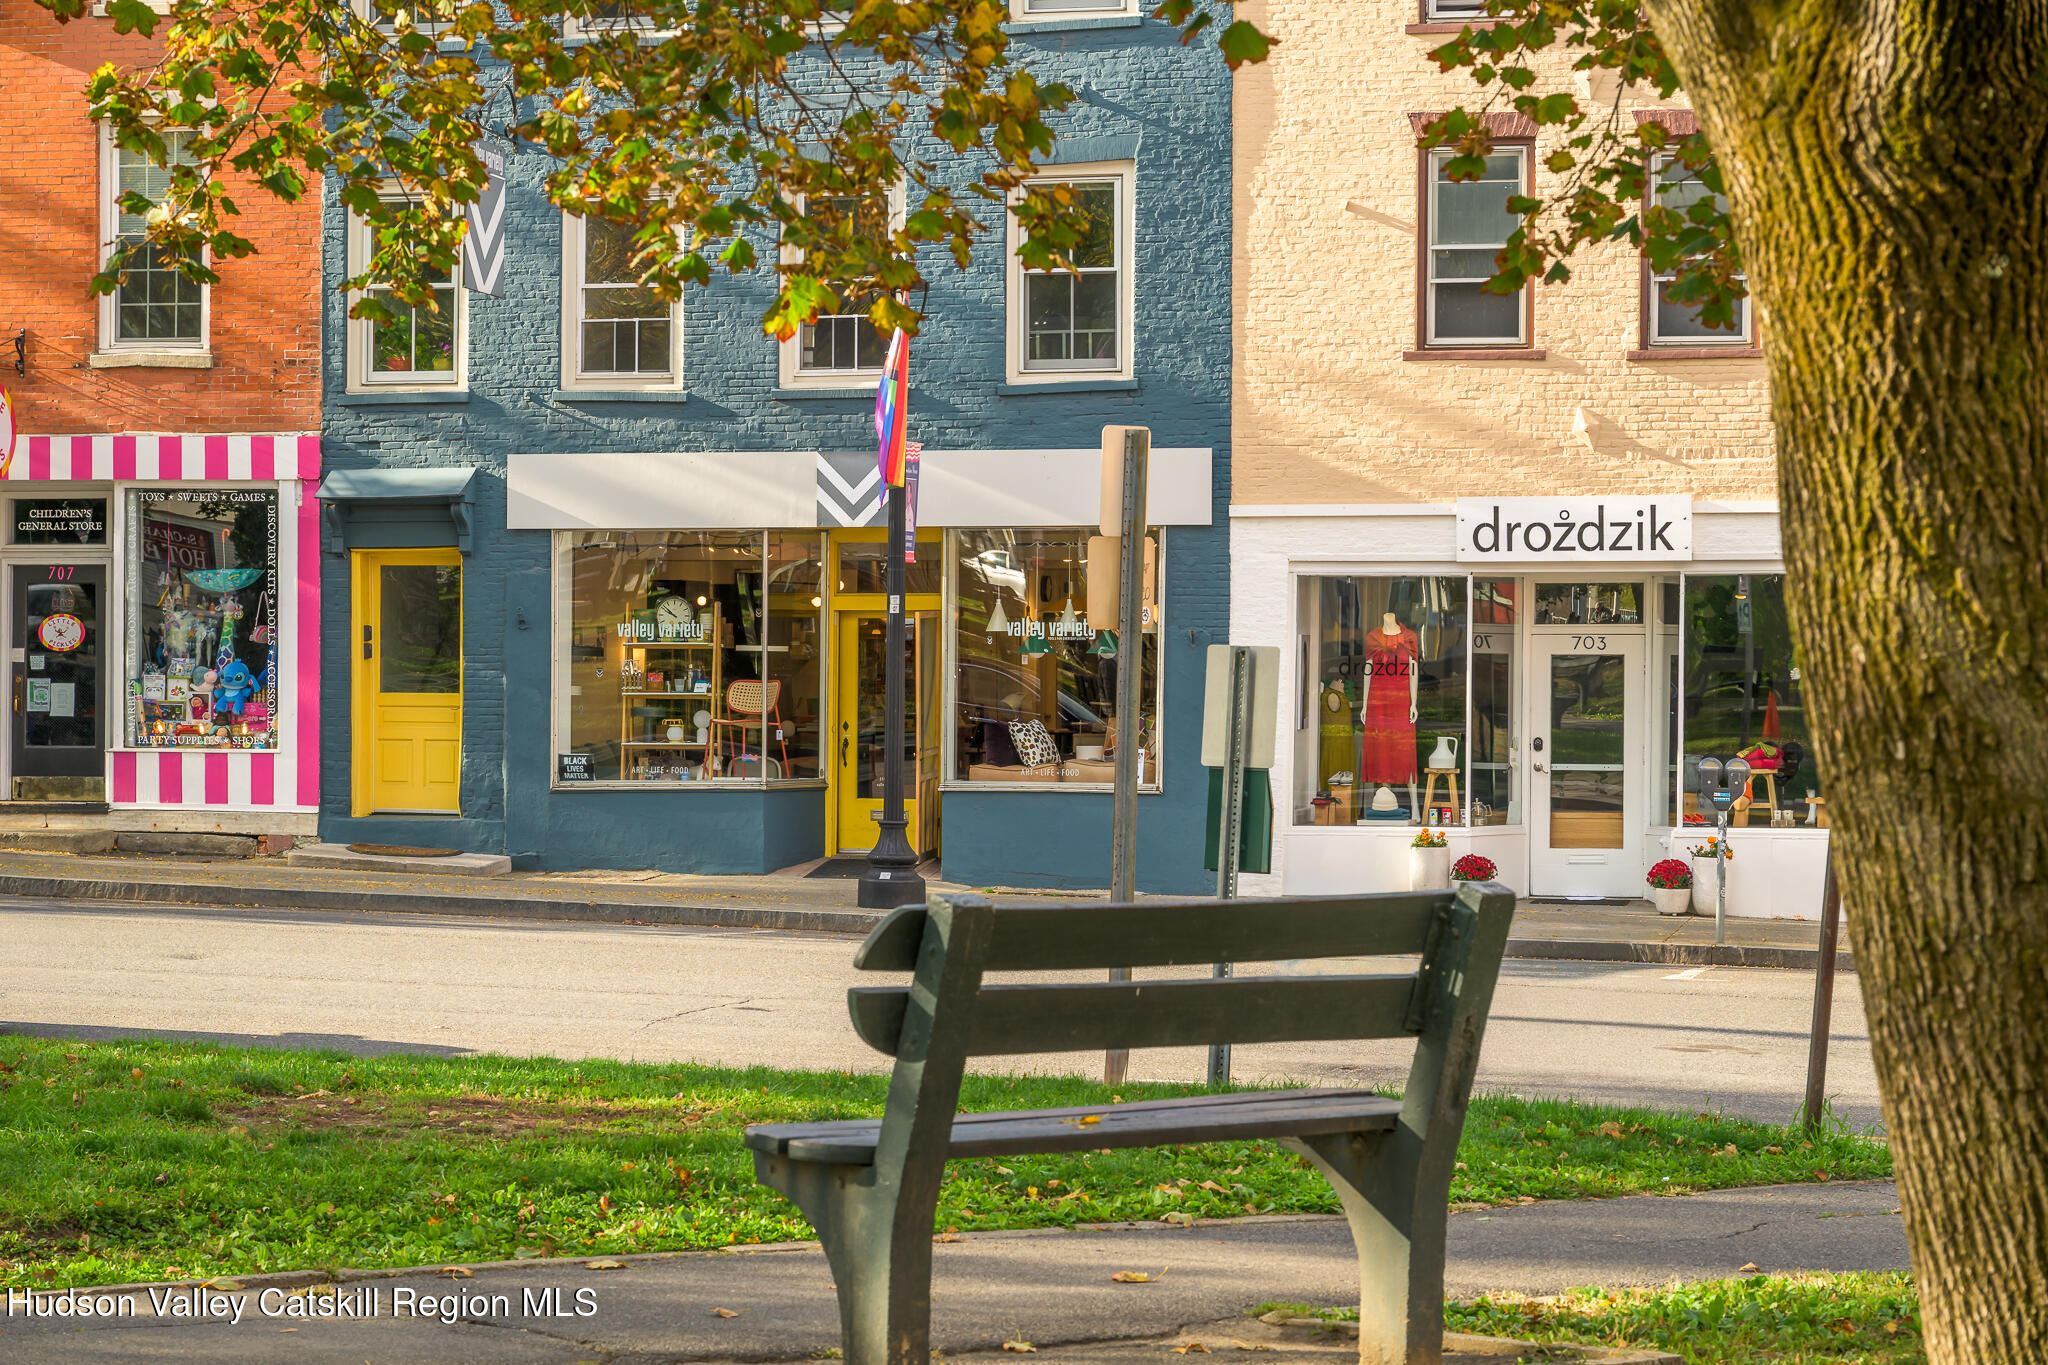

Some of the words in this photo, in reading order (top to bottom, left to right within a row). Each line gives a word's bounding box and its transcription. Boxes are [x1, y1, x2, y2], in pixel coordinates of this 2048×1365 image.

[138, 492, 165, 502] TOYS
[177, 492, 218, 502] SWEETS
[230, 492, 266, 502] GAMES
[29, 509, 92, 519] CHILDREN'S
[18, 521, 68, 531] GENERAL
[68, 521, 103, 531] STORE
[127, 505, 137, 549] CRAFTS
[267, 504, 277, 567] DISCOVERY
[48, 566, 75, 580] 707
[127, 563, 137, 592] ARTS
[267, 568, 277, 595] KITS
[47, 618, 76, 627] LITTLE
[267, 609, 276, 646] DOLLS
[1007, 617, 1045, 640] valley
[1049, 617, 1097, 640] variety
[127, 606, 137, 665] BALLOONS
[617, 619, 655, 641] valley
[658, 619, 704, 641] variety
[48, 637, 77, 648] PICKLES
[1571, 636, 1607, 650] 703
[267, 659, 276, 734] ACCESSORIES
[127, 679, 136, 732] MARBLES
[137, 735, 170, 745] PARTY
[171, 735, 220, 745] SUPPLIES
[232, 735, 266, 745] SHOES
[563, 756, 587, 765] BLACK
[631, 766, 643, 774] ART
[650, 766, 664, 774] LIFE
[670, 766, 689, 774] FOOD
[1021, 768, 1033, 776] ART
[1040, 768, 1055, 777] LIFE
[1061, 768, 1080, 777] FOOD
